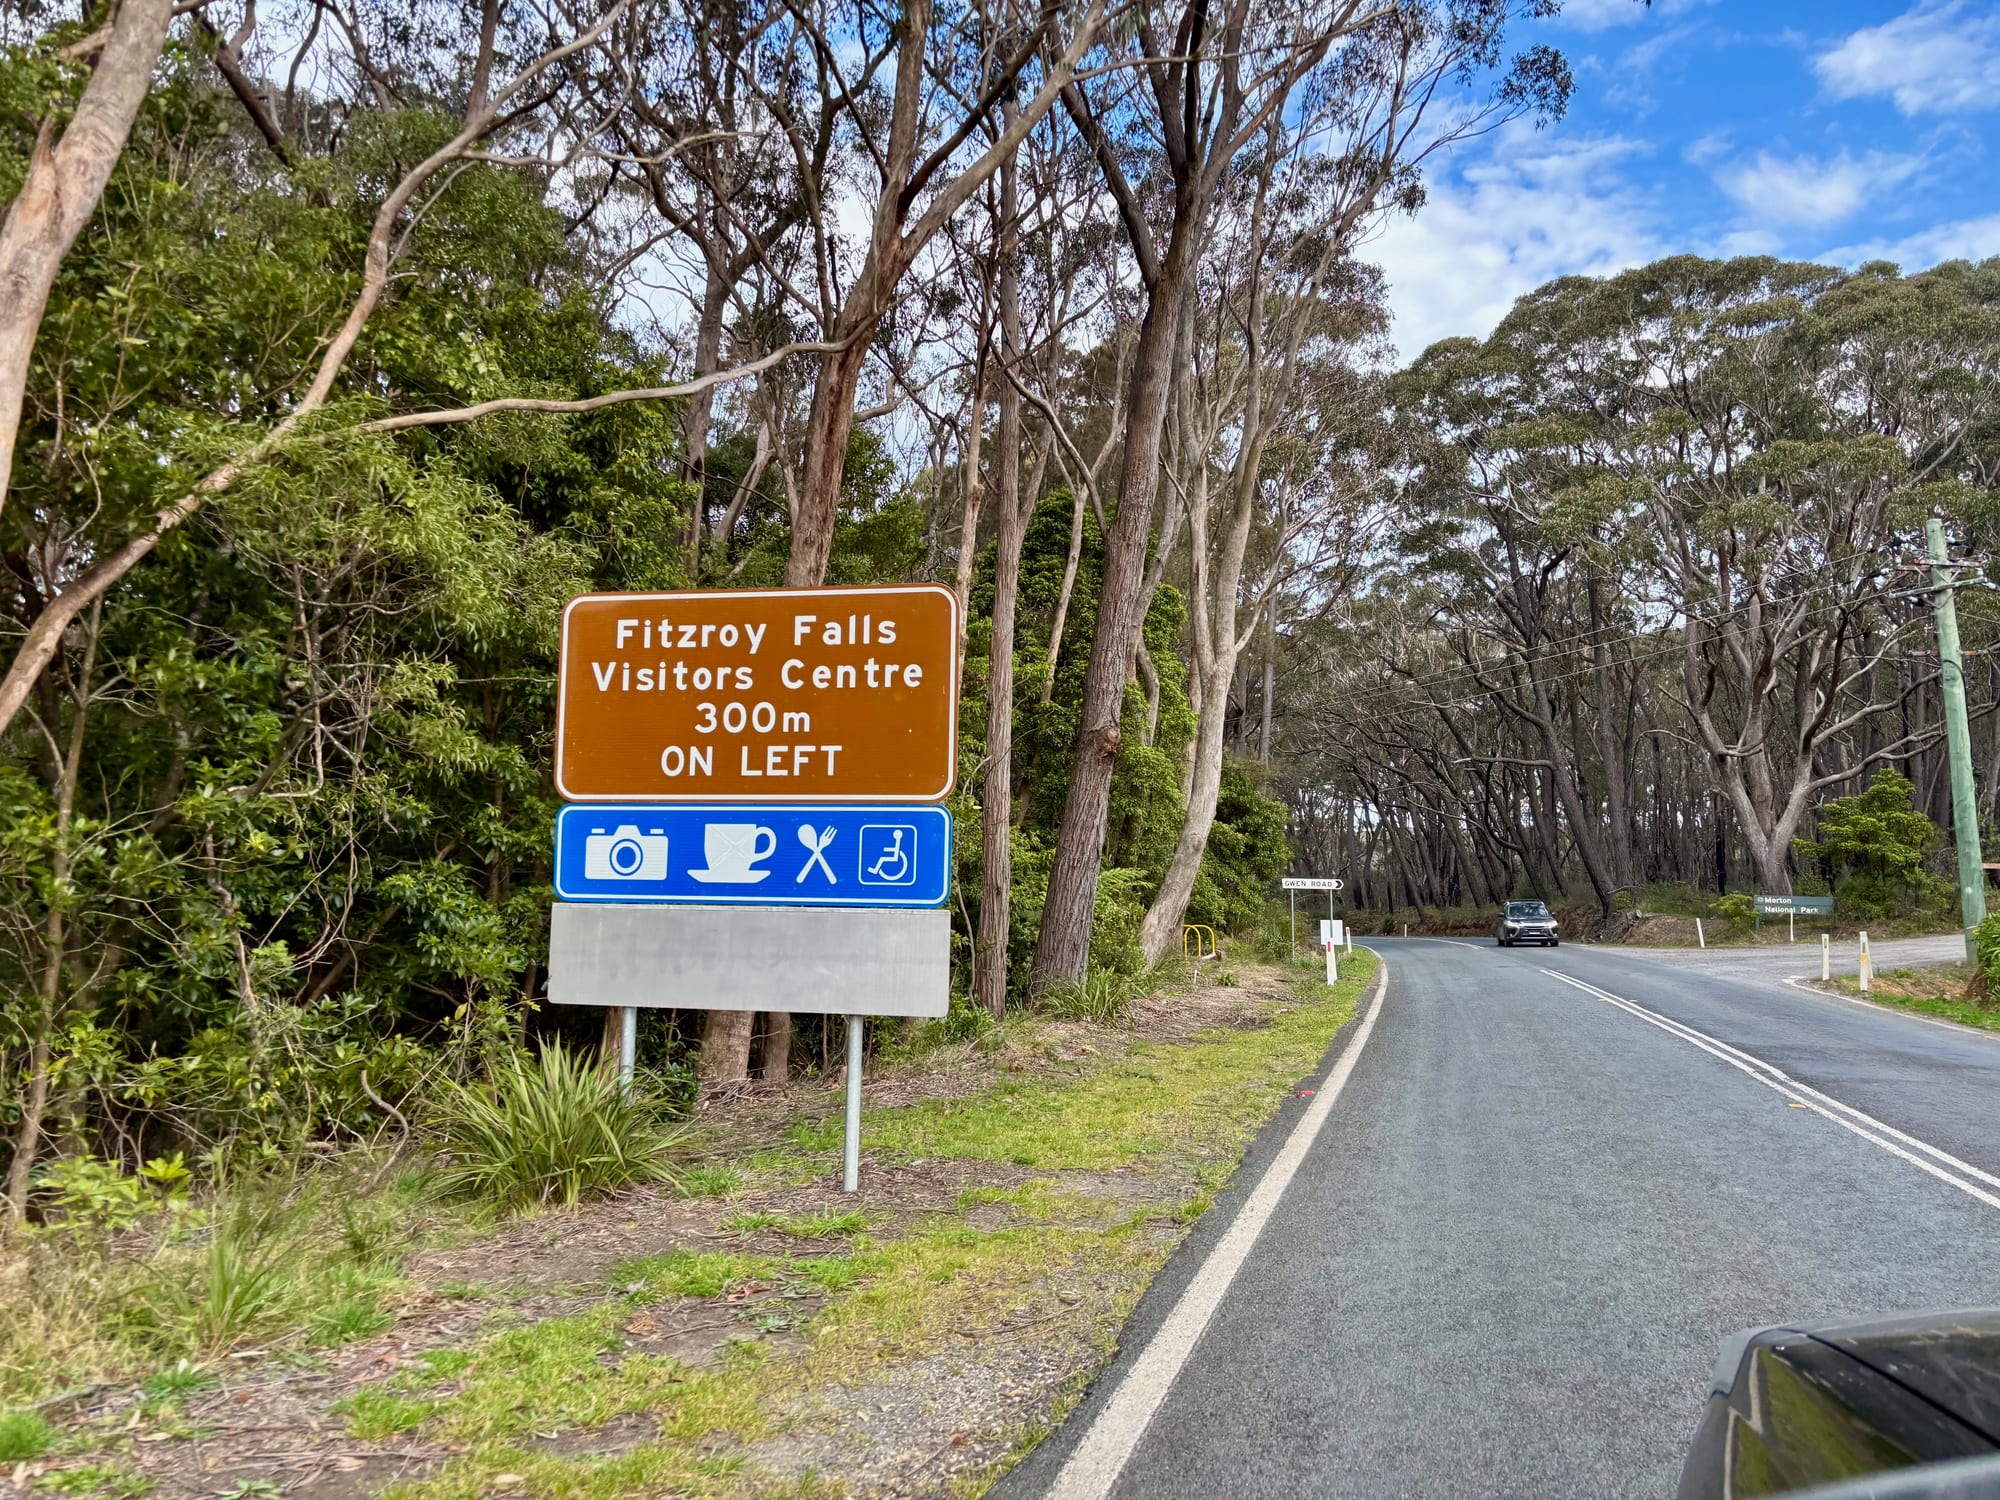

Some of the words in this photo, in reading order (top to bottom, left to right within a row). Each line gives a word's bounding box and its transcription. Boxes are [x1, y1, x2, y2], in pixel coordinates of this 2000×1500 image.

[616, 618, 767, 654] Fitzroy
[794, 614, 897, 646] Falls
[591, 660, 754, 692] Visitors
[781, 658, 923, 690] Centre
[694, 701, 811, 734] 300m
[661, 745, 713, 777] ON
[741, 745, 843, 777] LEFT
[1764, 896, 1792, 904] Morton
